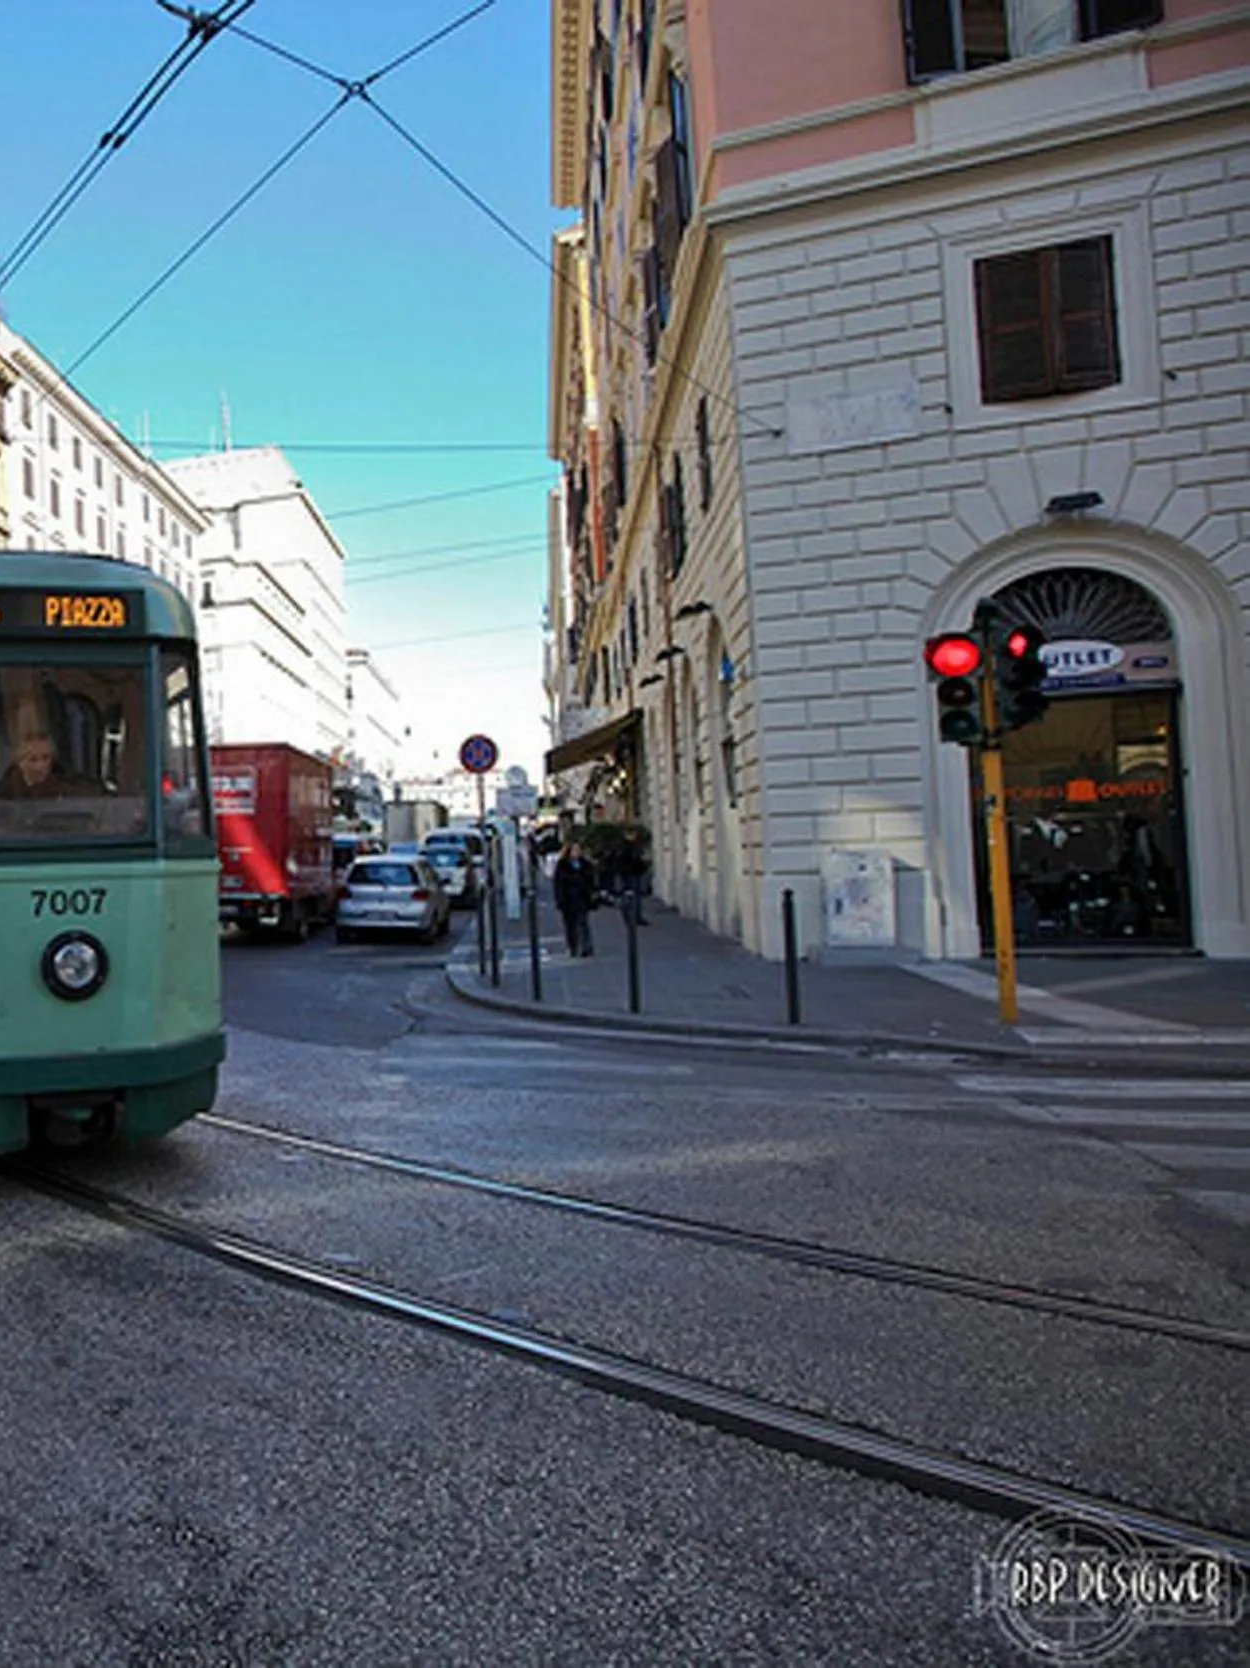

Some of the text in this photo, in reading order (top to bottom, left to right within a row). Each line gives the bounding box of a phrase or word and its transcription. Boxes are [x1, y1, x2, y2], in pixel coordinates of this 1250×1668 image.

[45, 595, 125, 628] PIAZZA
[1043, 648, 1113, 670] UTLET
[31, 887, 107, 918] 7007
